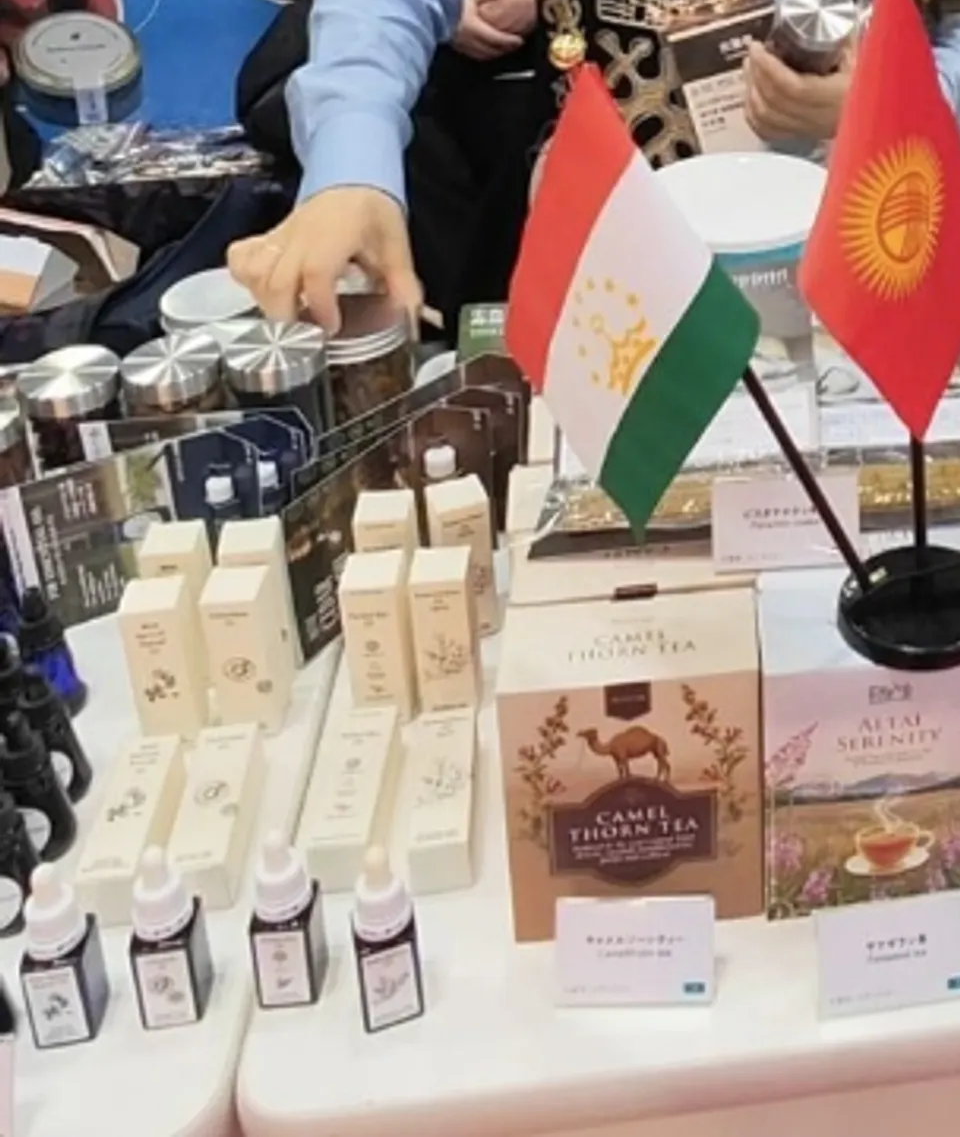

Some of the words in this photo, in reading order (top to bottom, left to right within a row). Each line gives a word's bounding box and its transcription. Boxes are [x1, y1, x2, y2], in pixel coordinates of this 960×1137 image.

[837, 727, 943, 752] SERENITY
[596, 805, 668, 826] CAMEL
[569, 824, 650, 842] THORN
[660, 817, 699, 835] TEA
